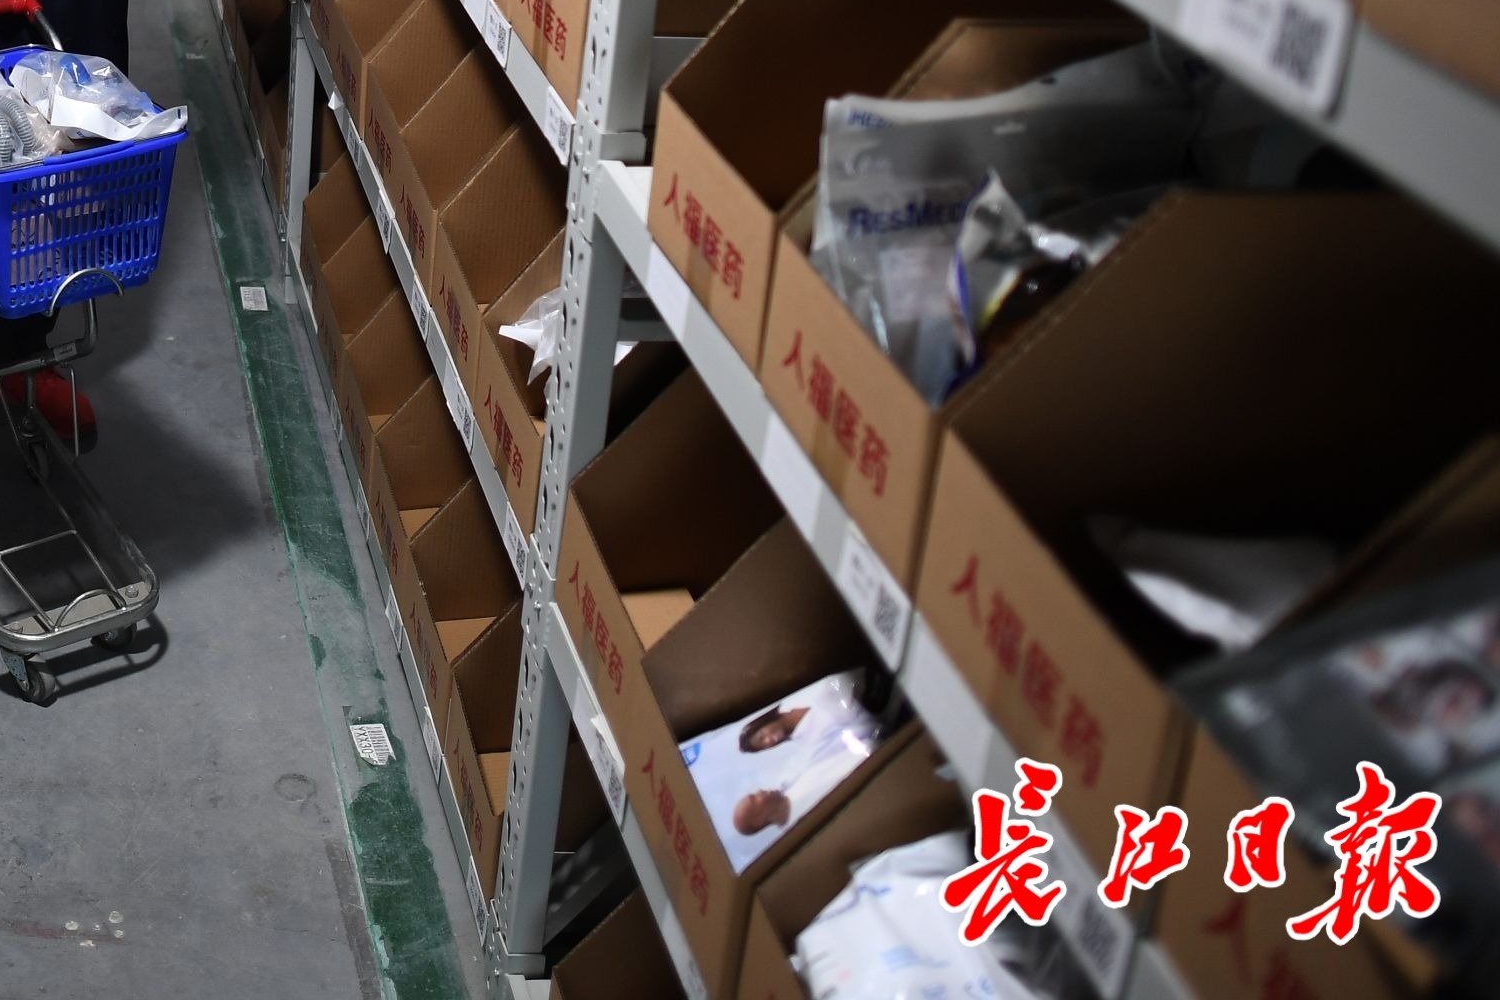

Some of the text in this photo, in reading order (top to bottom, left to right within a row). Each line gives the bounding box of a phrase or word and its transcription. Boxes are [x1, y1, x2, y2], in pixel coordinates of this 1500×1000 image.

[400, 183, 426, 259] 人福医药
[664, 172, 745, 299] 人福医药
[439, 274, 469, 363] 人福医药
[484, 384, 524, 489] 人福医药
[783, 329, 891, 497] 人福医药
[569, 560, 625, 695] 人福医药
[642, 750, 711, 917] 人福医药
